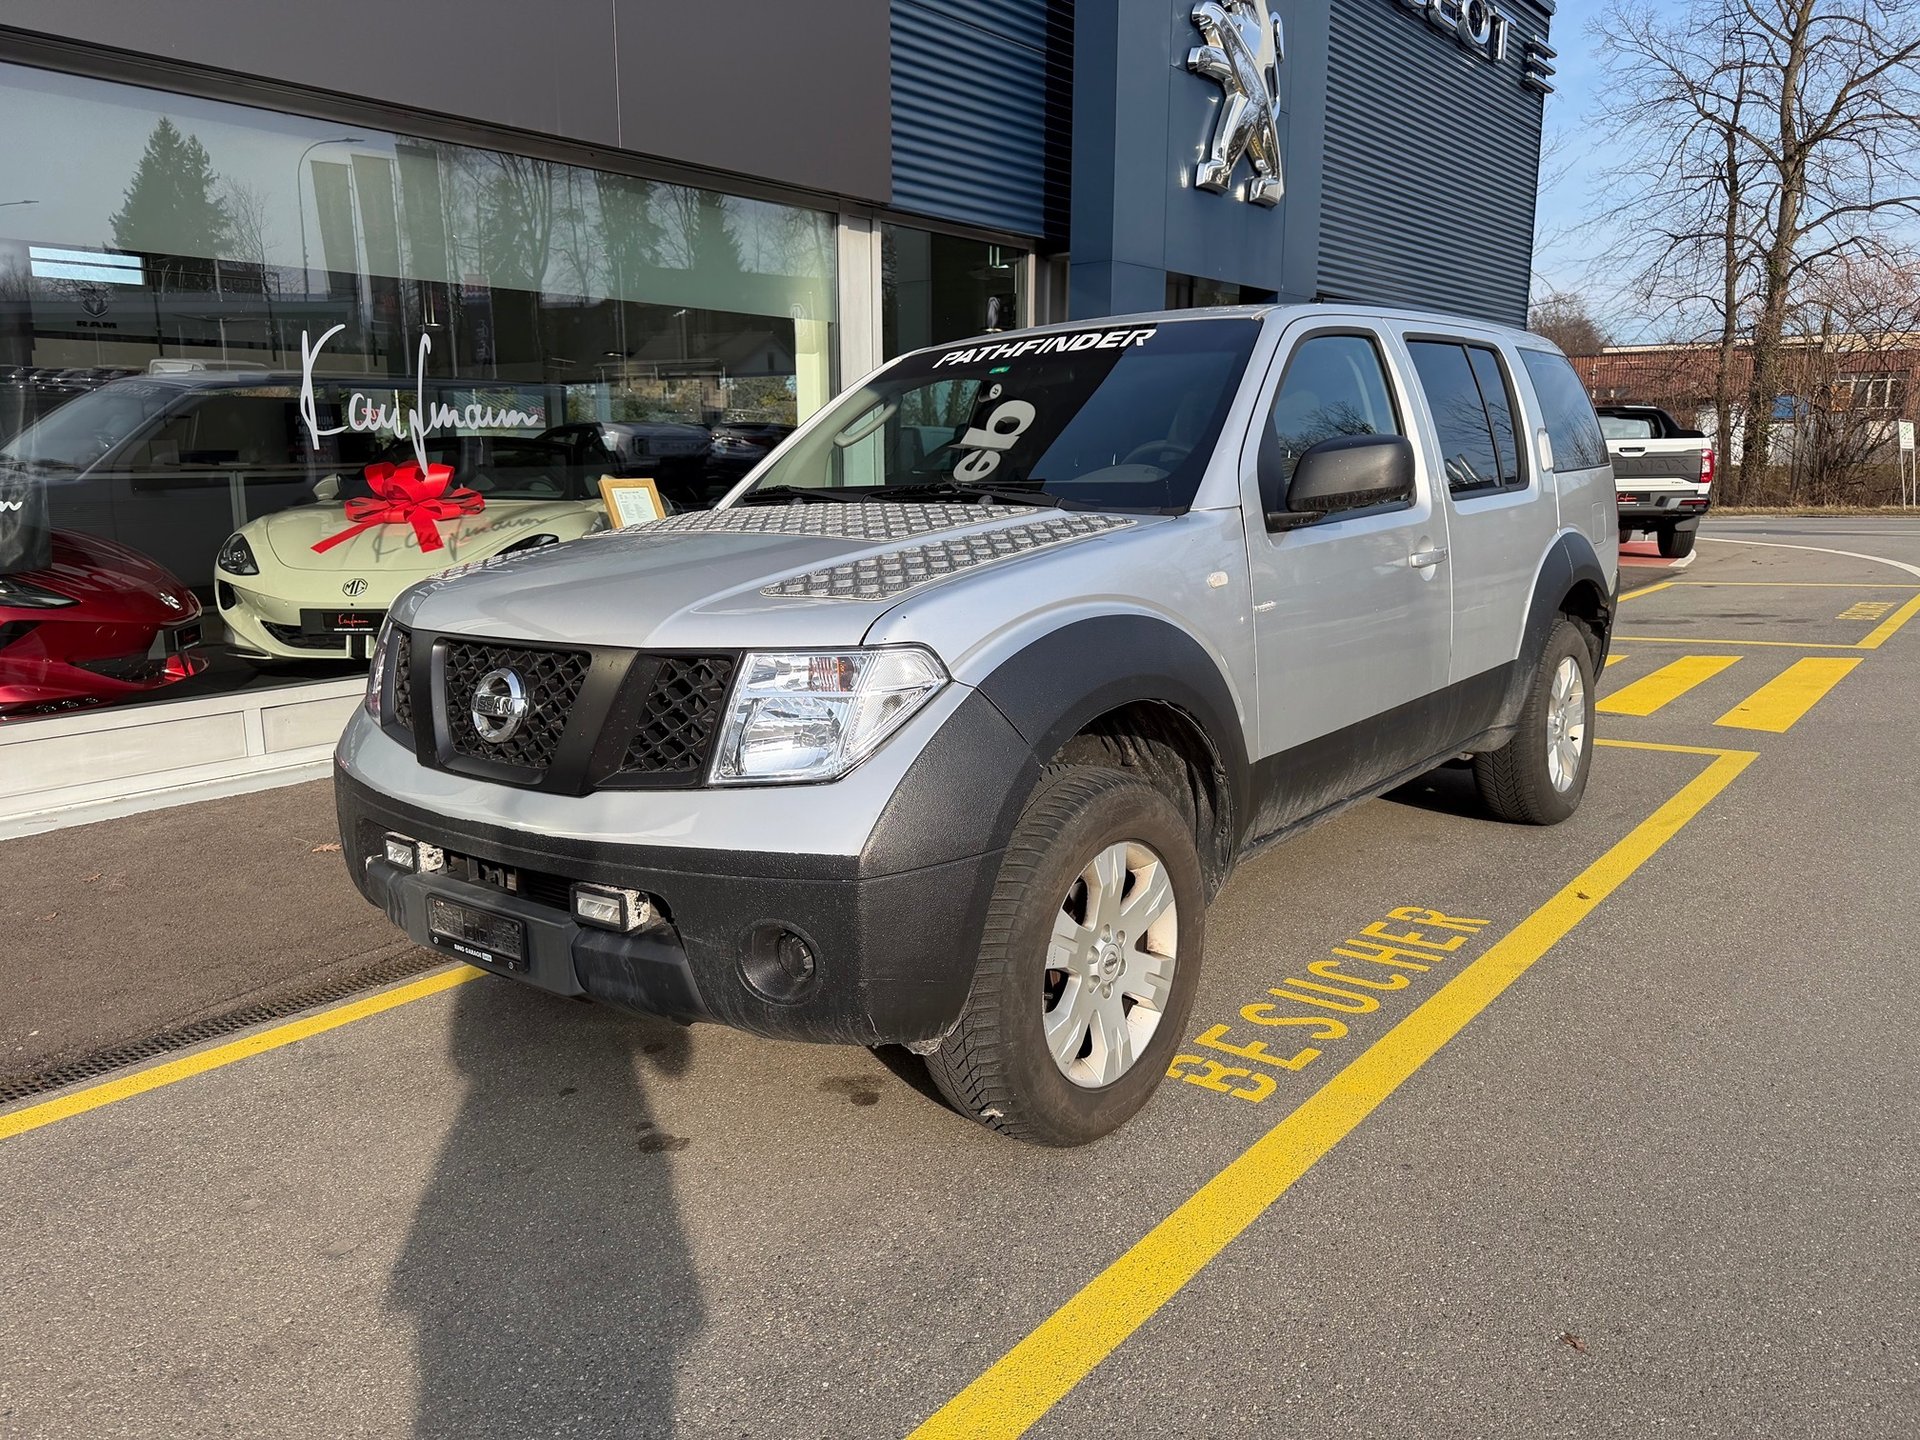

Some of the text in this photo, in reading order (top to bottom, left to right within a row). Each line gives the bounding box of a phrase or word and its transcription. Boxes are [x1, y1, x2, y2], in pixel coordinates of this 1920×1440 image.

[76, 320, 117, 329] RAM
[932, 328, 1157, 368] PATHFINDER
[343, 579, 367, 595] MG
[1166, 905, 1492, 1104] BESUCHER
